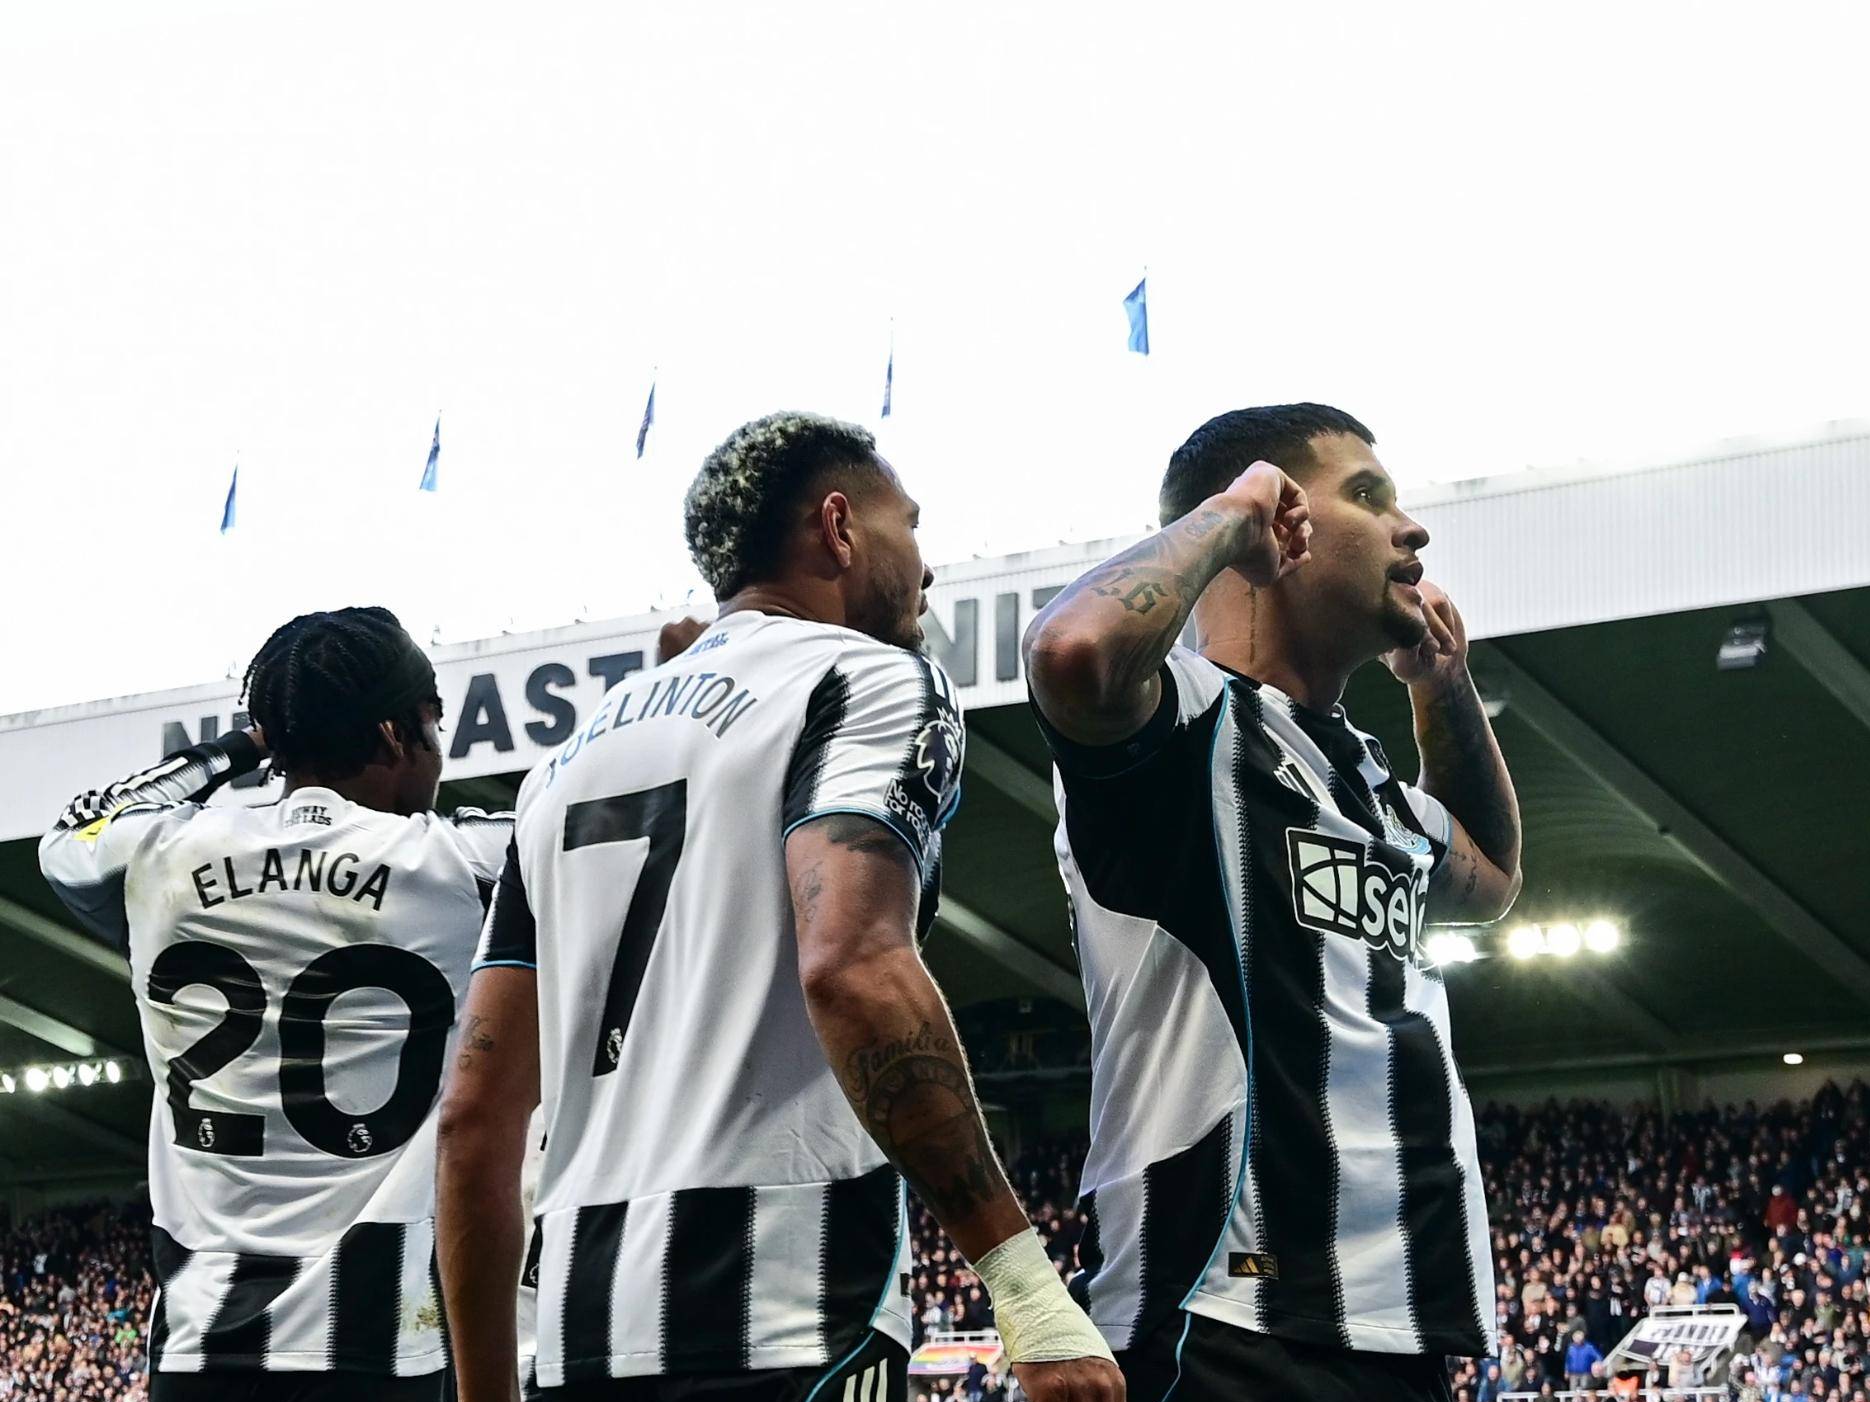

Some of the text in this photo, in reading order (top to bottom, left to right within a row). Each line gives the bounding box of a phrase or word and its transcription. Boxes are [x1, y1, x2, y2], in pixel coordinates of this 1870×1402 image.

[546, 672, 758, 789] JOELINTON
[191, 847, 392, 912] ELANGA
[562, 778, 688, 1078] 7
[148, 940, 456, 1158] 20
